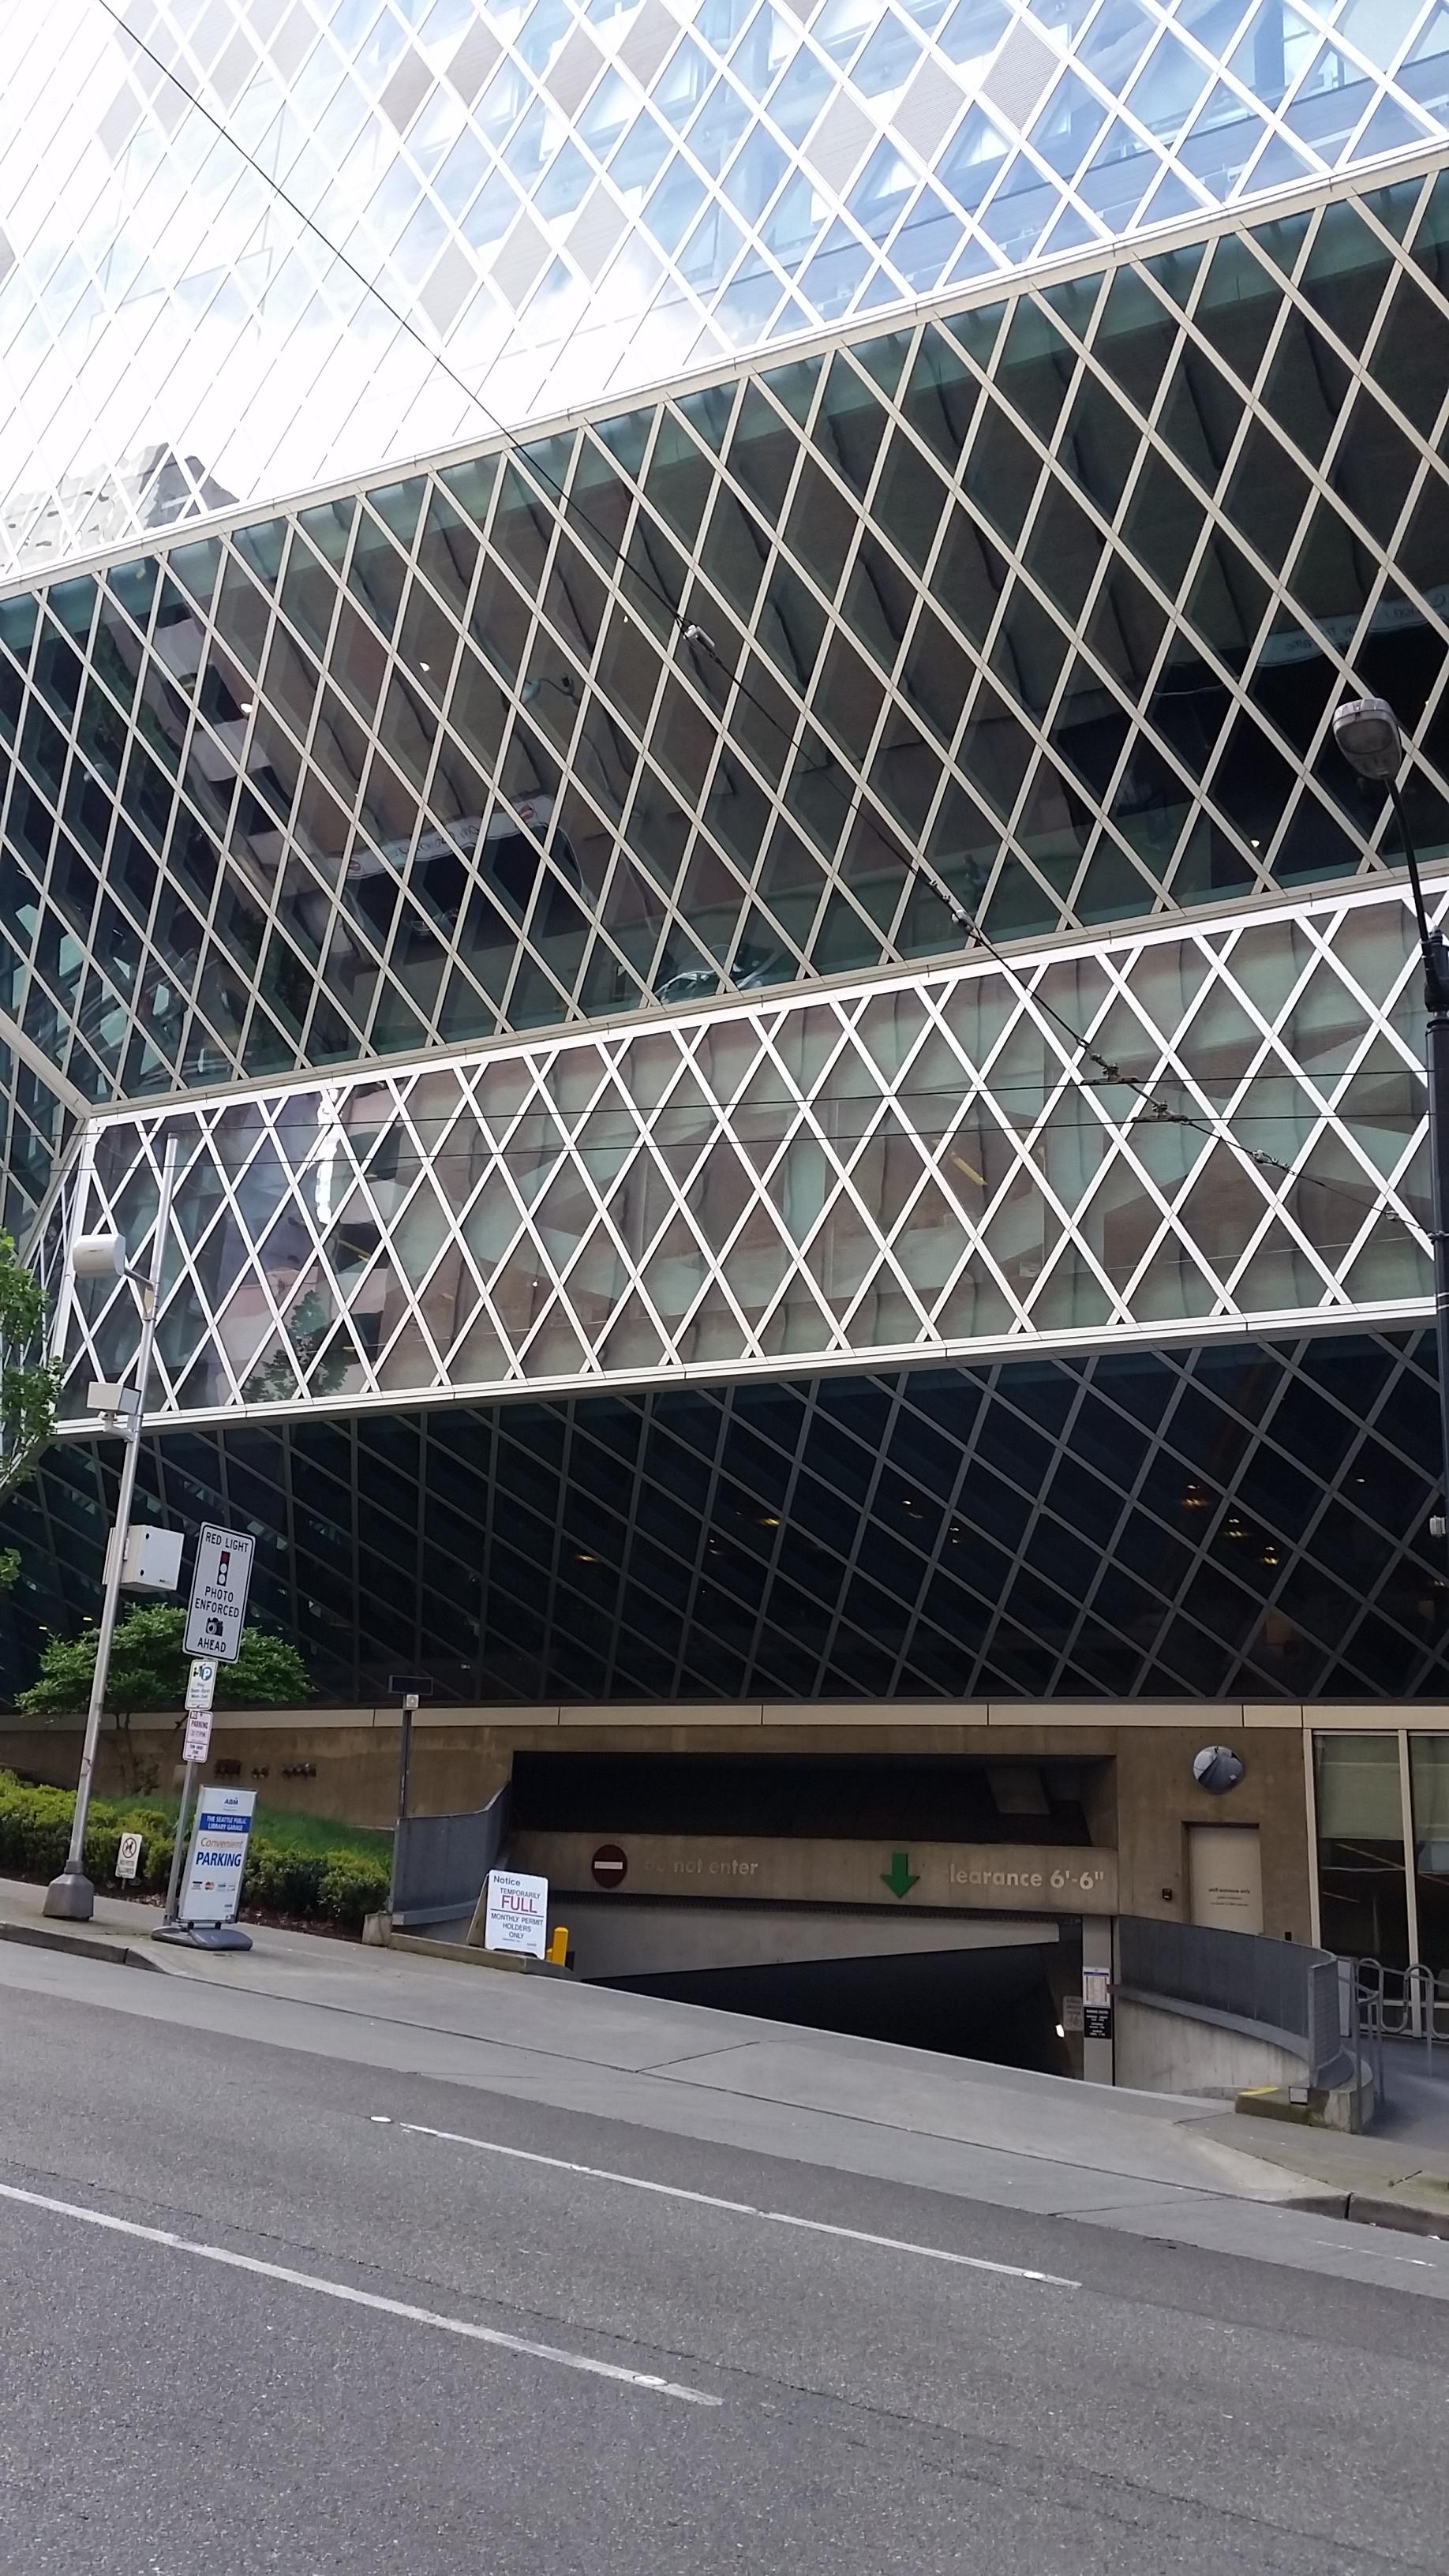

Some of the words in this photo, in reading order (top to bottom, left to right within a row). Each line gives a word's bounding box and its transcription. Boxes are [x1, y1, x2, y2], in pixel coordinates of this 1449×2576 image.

[206, 1532, 222, 1546] RED
[226, 1538, 249, 1552] LIGHT
[204, 1586, 234, 1602] PHOTO
[195, 1598, 239, 1618] ENFORCED
[197, 1637, 227, 1653] AHEAD
[201, 1837, 243, 1848] Convenient
[196, 1852, 242, 1866] PARKING
[674, 1859, 702, 1874] not
[710, 1859, 758, 1875] enter
[493, 1875, 521, 1886] Notice
[500, 1888, 540, 1899] TEMPORARILY
[501, 1895, 537, 1913] FULL
[491, 1913, 519, 1923] MONTHLY
[522, 1917, 543, 1926] PERMIT
[503, 1923, 531, 1932] HOLDERS
